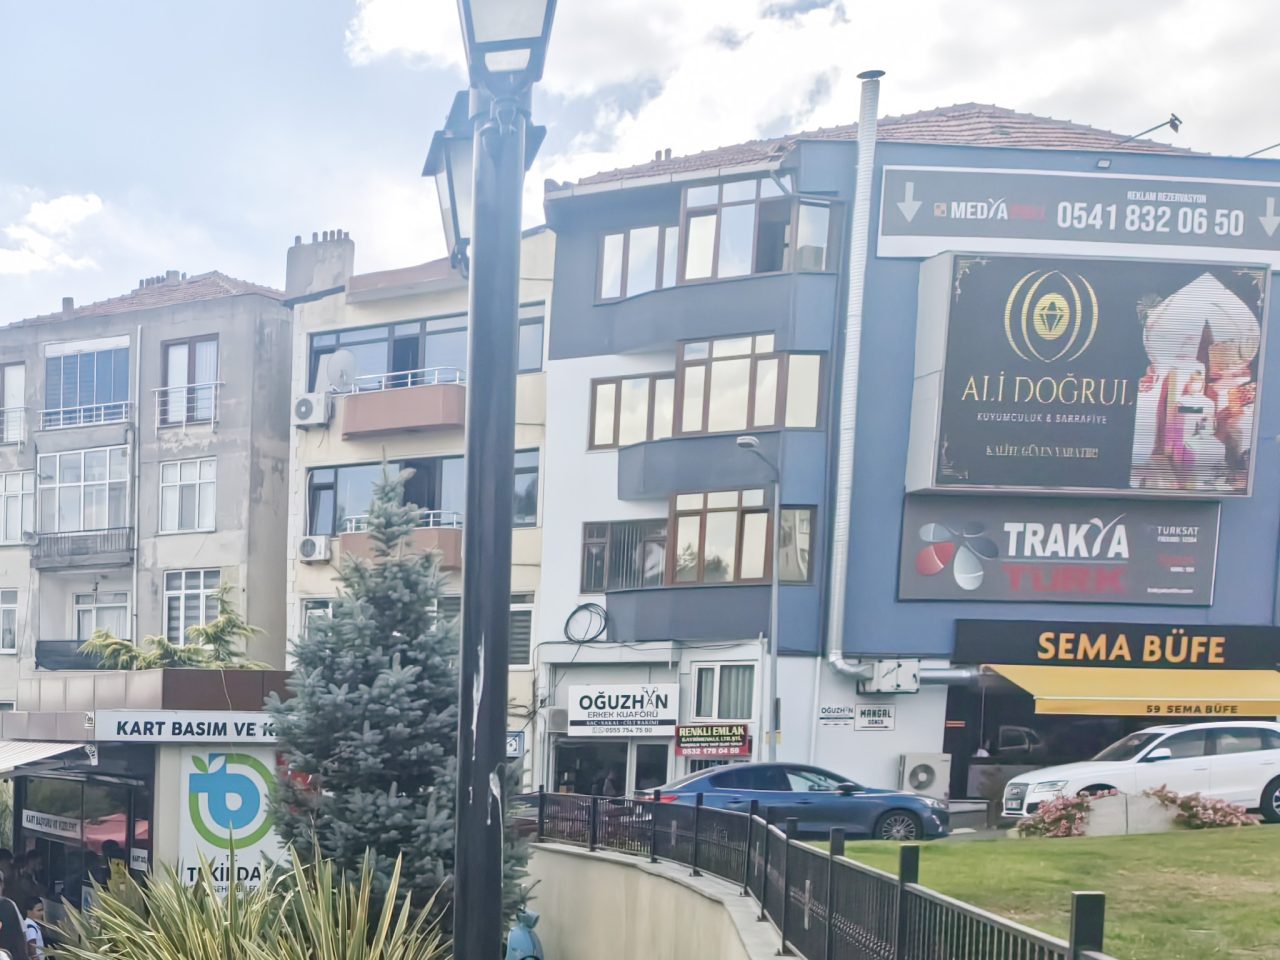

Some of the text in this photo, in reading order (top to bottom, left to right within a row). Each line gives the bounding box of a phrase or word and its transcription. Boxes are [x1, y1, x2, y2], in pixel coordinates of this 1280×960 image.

[951, 198, 1008, 220] MEDYA
[1057, 201, 1116, 230] 0541
[1125, 204, 1170, 232] 832
[1178, 208, 1208, 234] 06
[1214, 209, 1244, 236] 50
[962, 370, 1134, 406] ALİ DOĞRUL
[976, 412, 1042, 422] KUYUMCULUK
[1004, 513, 1130, 558] TRAKYA
[1037, 628, 1226, 664] SEMA BÜFE
[1146, 702, 1238, 714] 59 SEMA BÜFE
[116, 720, 166, 736] KART
[171, 721, 226, 736] BASIM
[234, 722, 256, 737] VE
[712, 726, 744, 736] EMLAK
